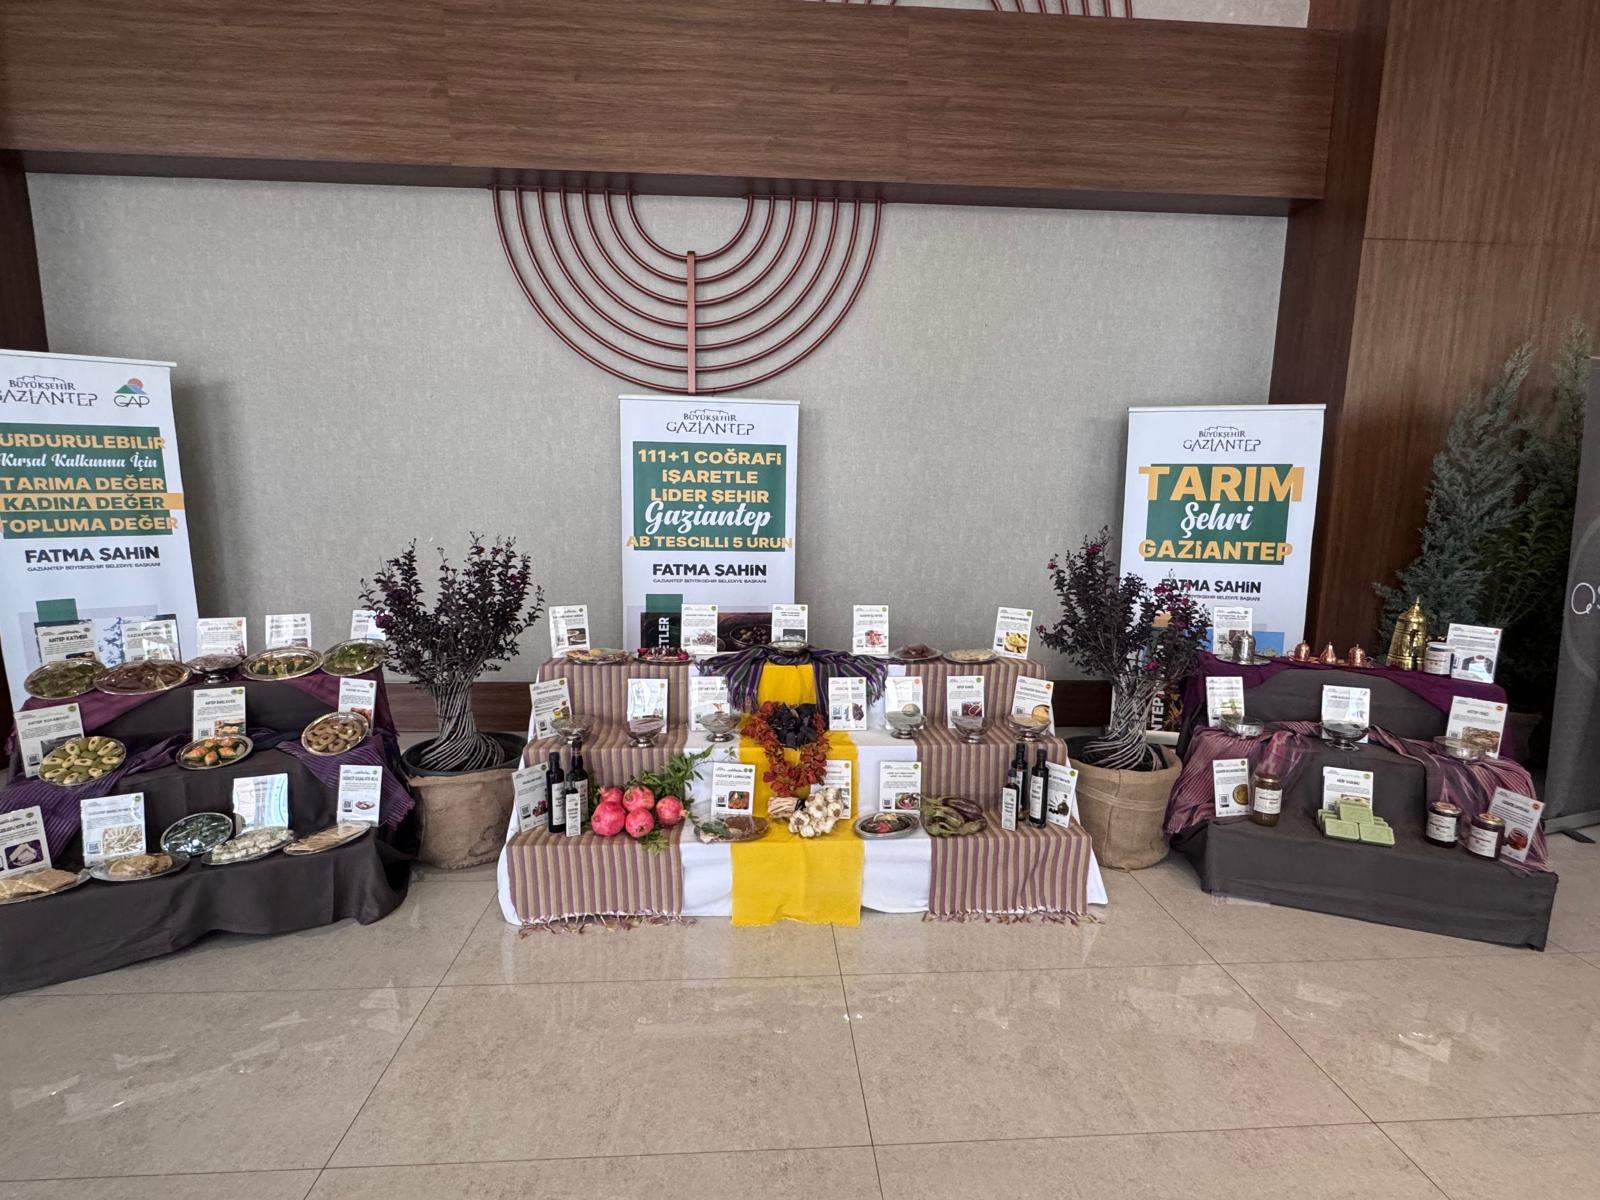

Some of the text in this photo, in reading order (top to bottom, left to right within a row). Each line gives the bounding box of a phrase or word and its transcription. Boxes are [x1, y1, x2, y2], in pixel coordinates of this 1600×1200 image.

[9, 379, 76, 391] BÜYÜKŞEHİR
[0, 389, 98, 407] AZİANTEP
[113, 394, 150, 408] GAP
[683, 412, 737, 422] BÜYÜKŞEHİR
[666, 420, 755, 436] GAZİANTEP
[1199, 430, 1246, 438] BÜYÜKŞEHİR
[0, 433, 165, 450] ÜRDÜRÜLEBİLİR
[1182, 438, 1262, 452] GAZİANTEP
[0, 451, 157, 471] Kırsal Kalkınma İçin
[638, 448, 782, 465] 111+1 COĞRAFİ
[0, 474, 165, 491] TARIMA DEĞER
[662, 469, 758, 484] İŞARETLE
[1138, 466, 1305, 502] TARIM
[4, 494, 165, 510] KADINA DEĞER
[650, 488, 769, 504] LİDER ŞEHİR
[109, 514, 178, 530] DEĞER
[645, 500, 771, 535] Gaziantep
[1180, 501, 1254, 539] Şehri
[626, 535, 792, 549] AB TESCİLLİ 5 ÜRÜN
[1138, 539, 1293, 561] GAZİANTEP
[25, 548, 95, 563] FATMA
[653, 563, 767, 577] FATMA ŞAHİN
[1571, 582, 1600, 615] Q
